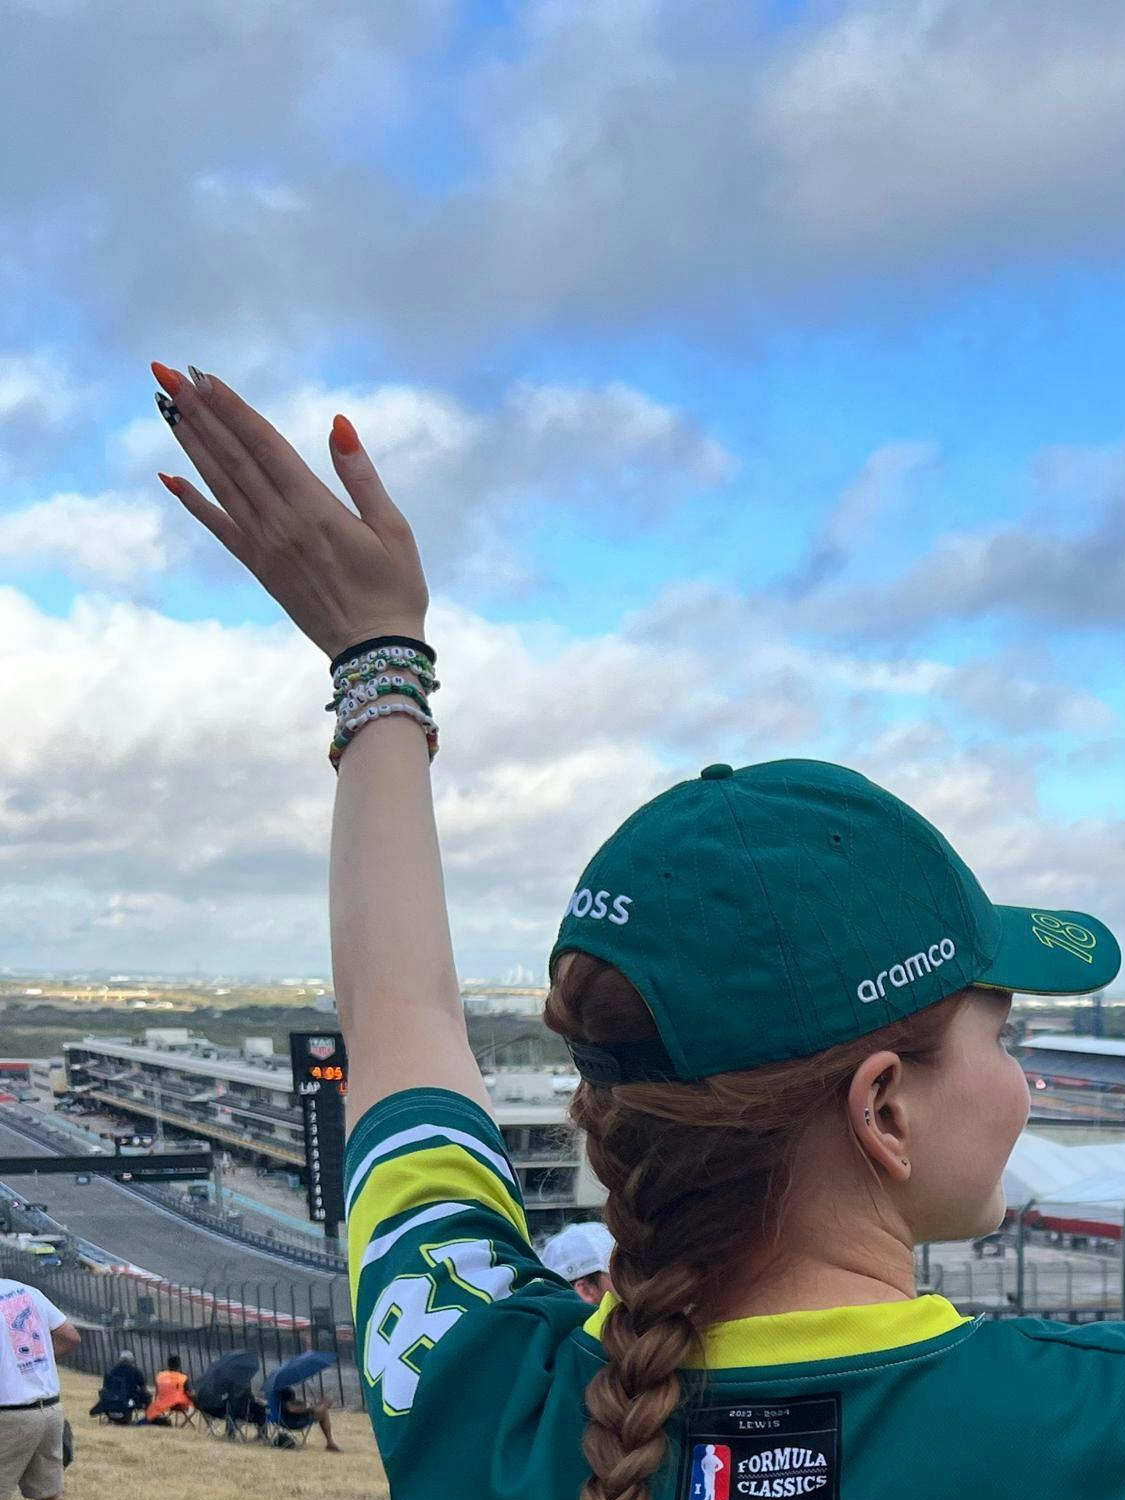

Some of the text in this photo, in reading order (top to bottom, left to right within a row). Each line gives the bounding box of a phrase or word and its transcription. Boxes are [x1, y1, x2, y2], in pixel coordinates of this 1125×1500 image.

[564, 888, 633, 925] OSS
[1031, 913, 1096, 963] 18
[857, 938, 956, 1004] aramco
[300, 1082, 321, 1095] LAP
[739, 1420, 781, 1429] LEWIS
[737, 1447, 828, 1473] FORMULA
[737, 1475, 828, 1498] CLASSICS
